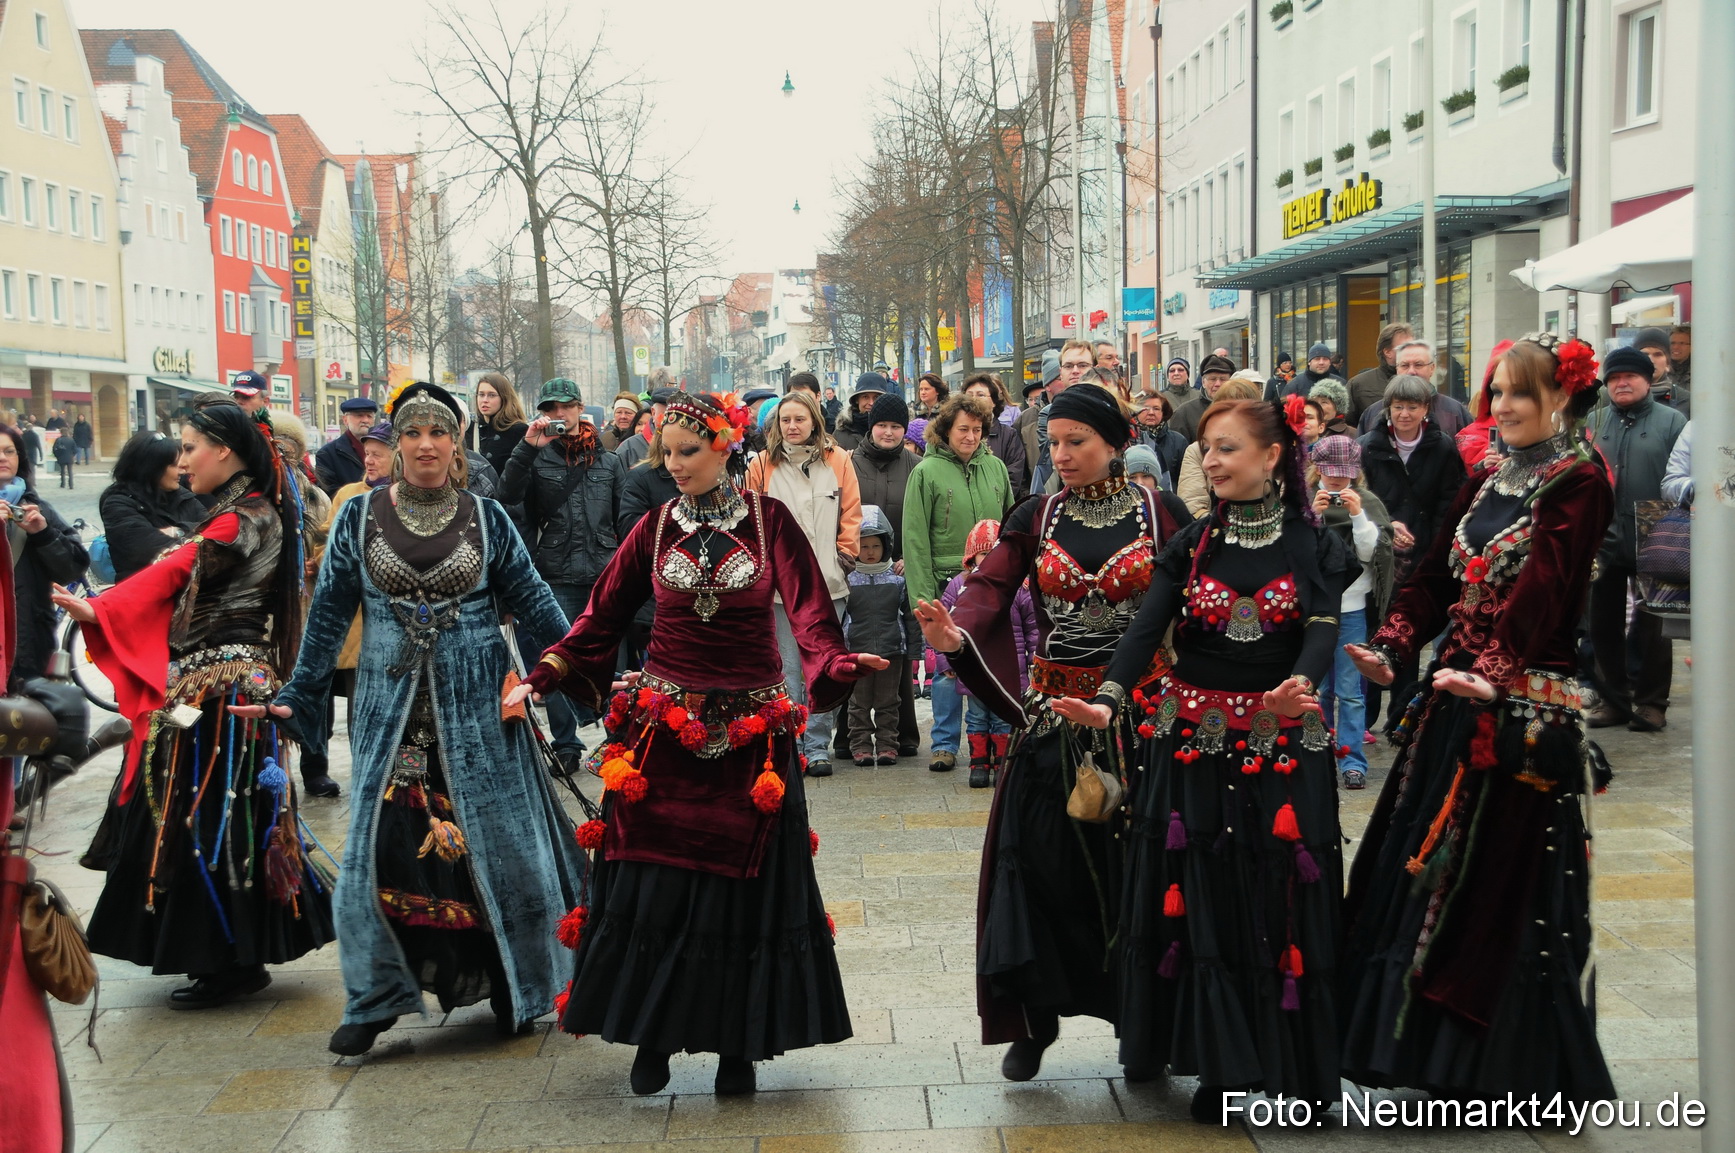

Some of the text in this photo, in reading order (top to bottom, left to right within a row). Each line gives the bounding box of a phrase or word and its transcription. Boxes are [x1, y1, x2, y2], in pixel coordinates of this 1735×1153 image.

[1282, 172, 1382, 240] mayer schuhe
[293, 237, 313, 336] HOTEL
